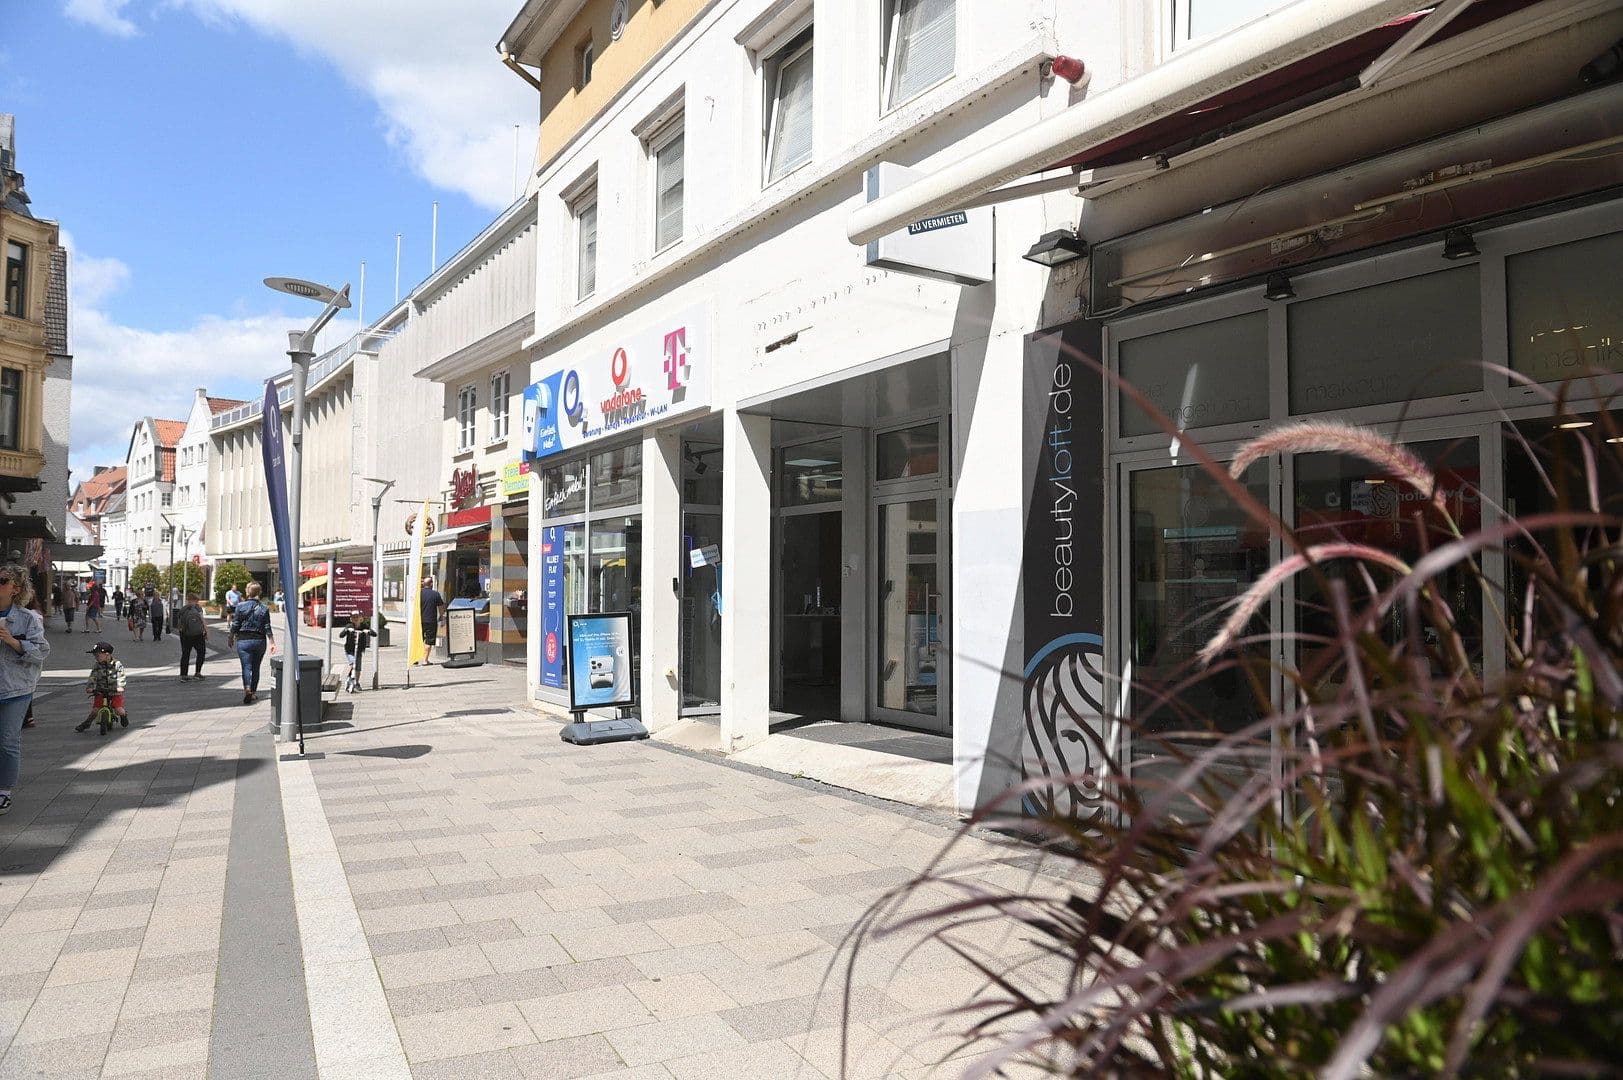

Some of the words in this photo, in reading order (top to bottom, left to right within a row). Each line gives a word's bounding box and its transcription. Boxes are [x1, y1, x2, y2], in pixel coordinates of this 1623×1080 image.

[911, 222, 921, 232] ZU
[922, 213, 965, 231] VERMIETEN
[600, 387, 642, 413] vodafone
[650, 404, 668, 417] W-LAN
[1048, 363, 1078, 617] beautyloft.de
